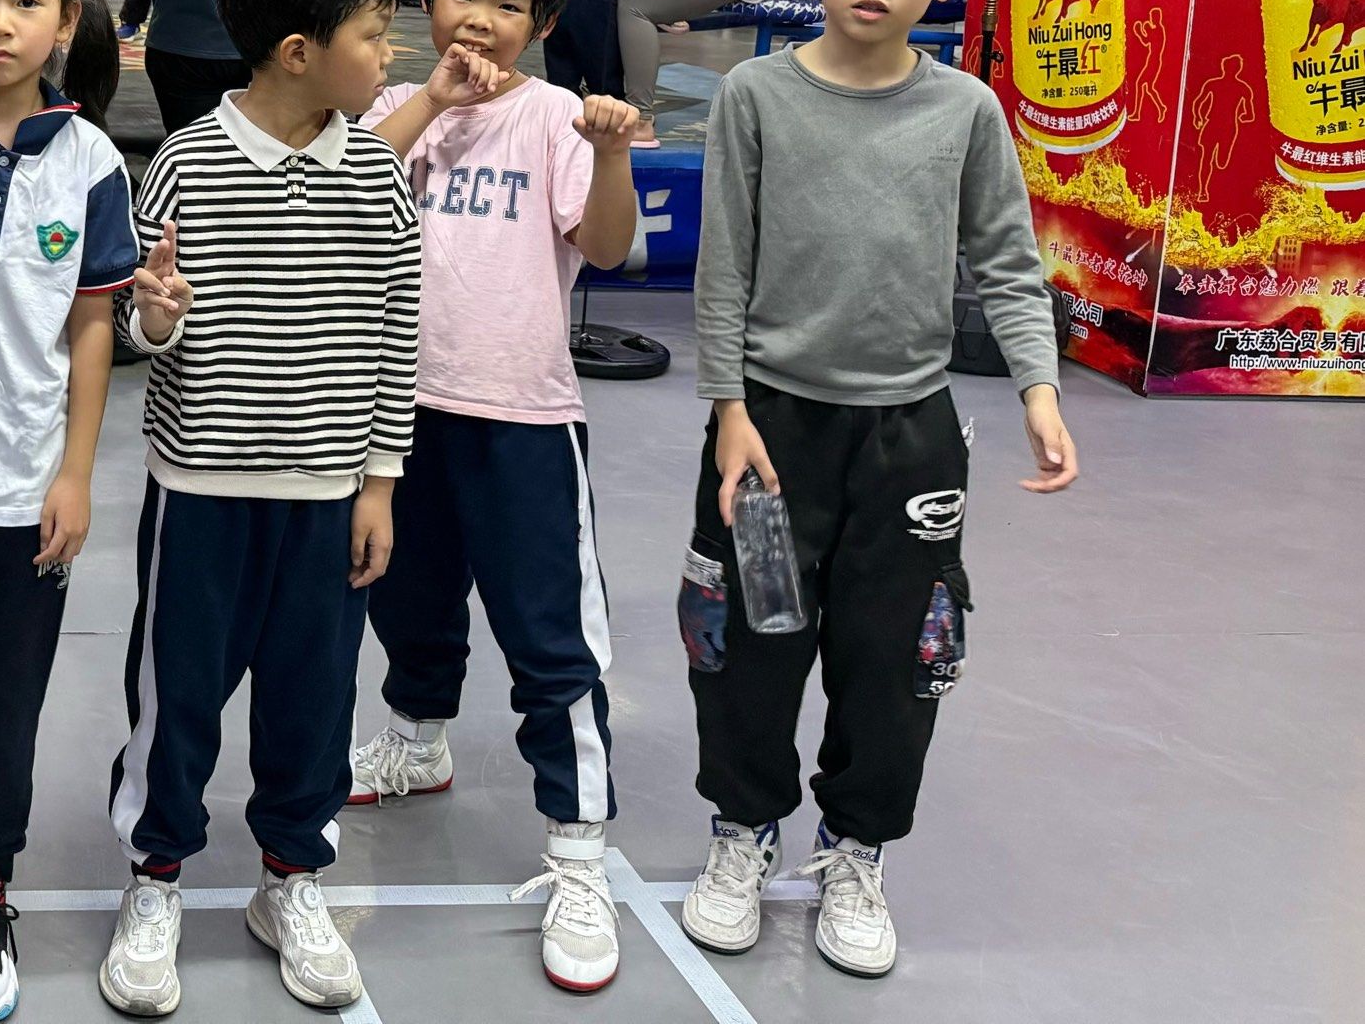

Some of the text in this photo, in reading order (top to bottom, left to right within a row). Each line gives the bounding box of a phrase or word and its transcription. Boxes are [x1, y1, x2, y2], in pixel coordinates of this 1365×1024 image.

[1028, 21, 1112, 45] Niu Zui Hong
[1036, 40, 1102, 82] 牛最红
[1292, 49, 1360, 81] Niu Zui
[1018, 98, 1119, 131] 牛最红维生素能量风味饮料
[1215, 328, 1365, 353] 广东荔合贸易有
